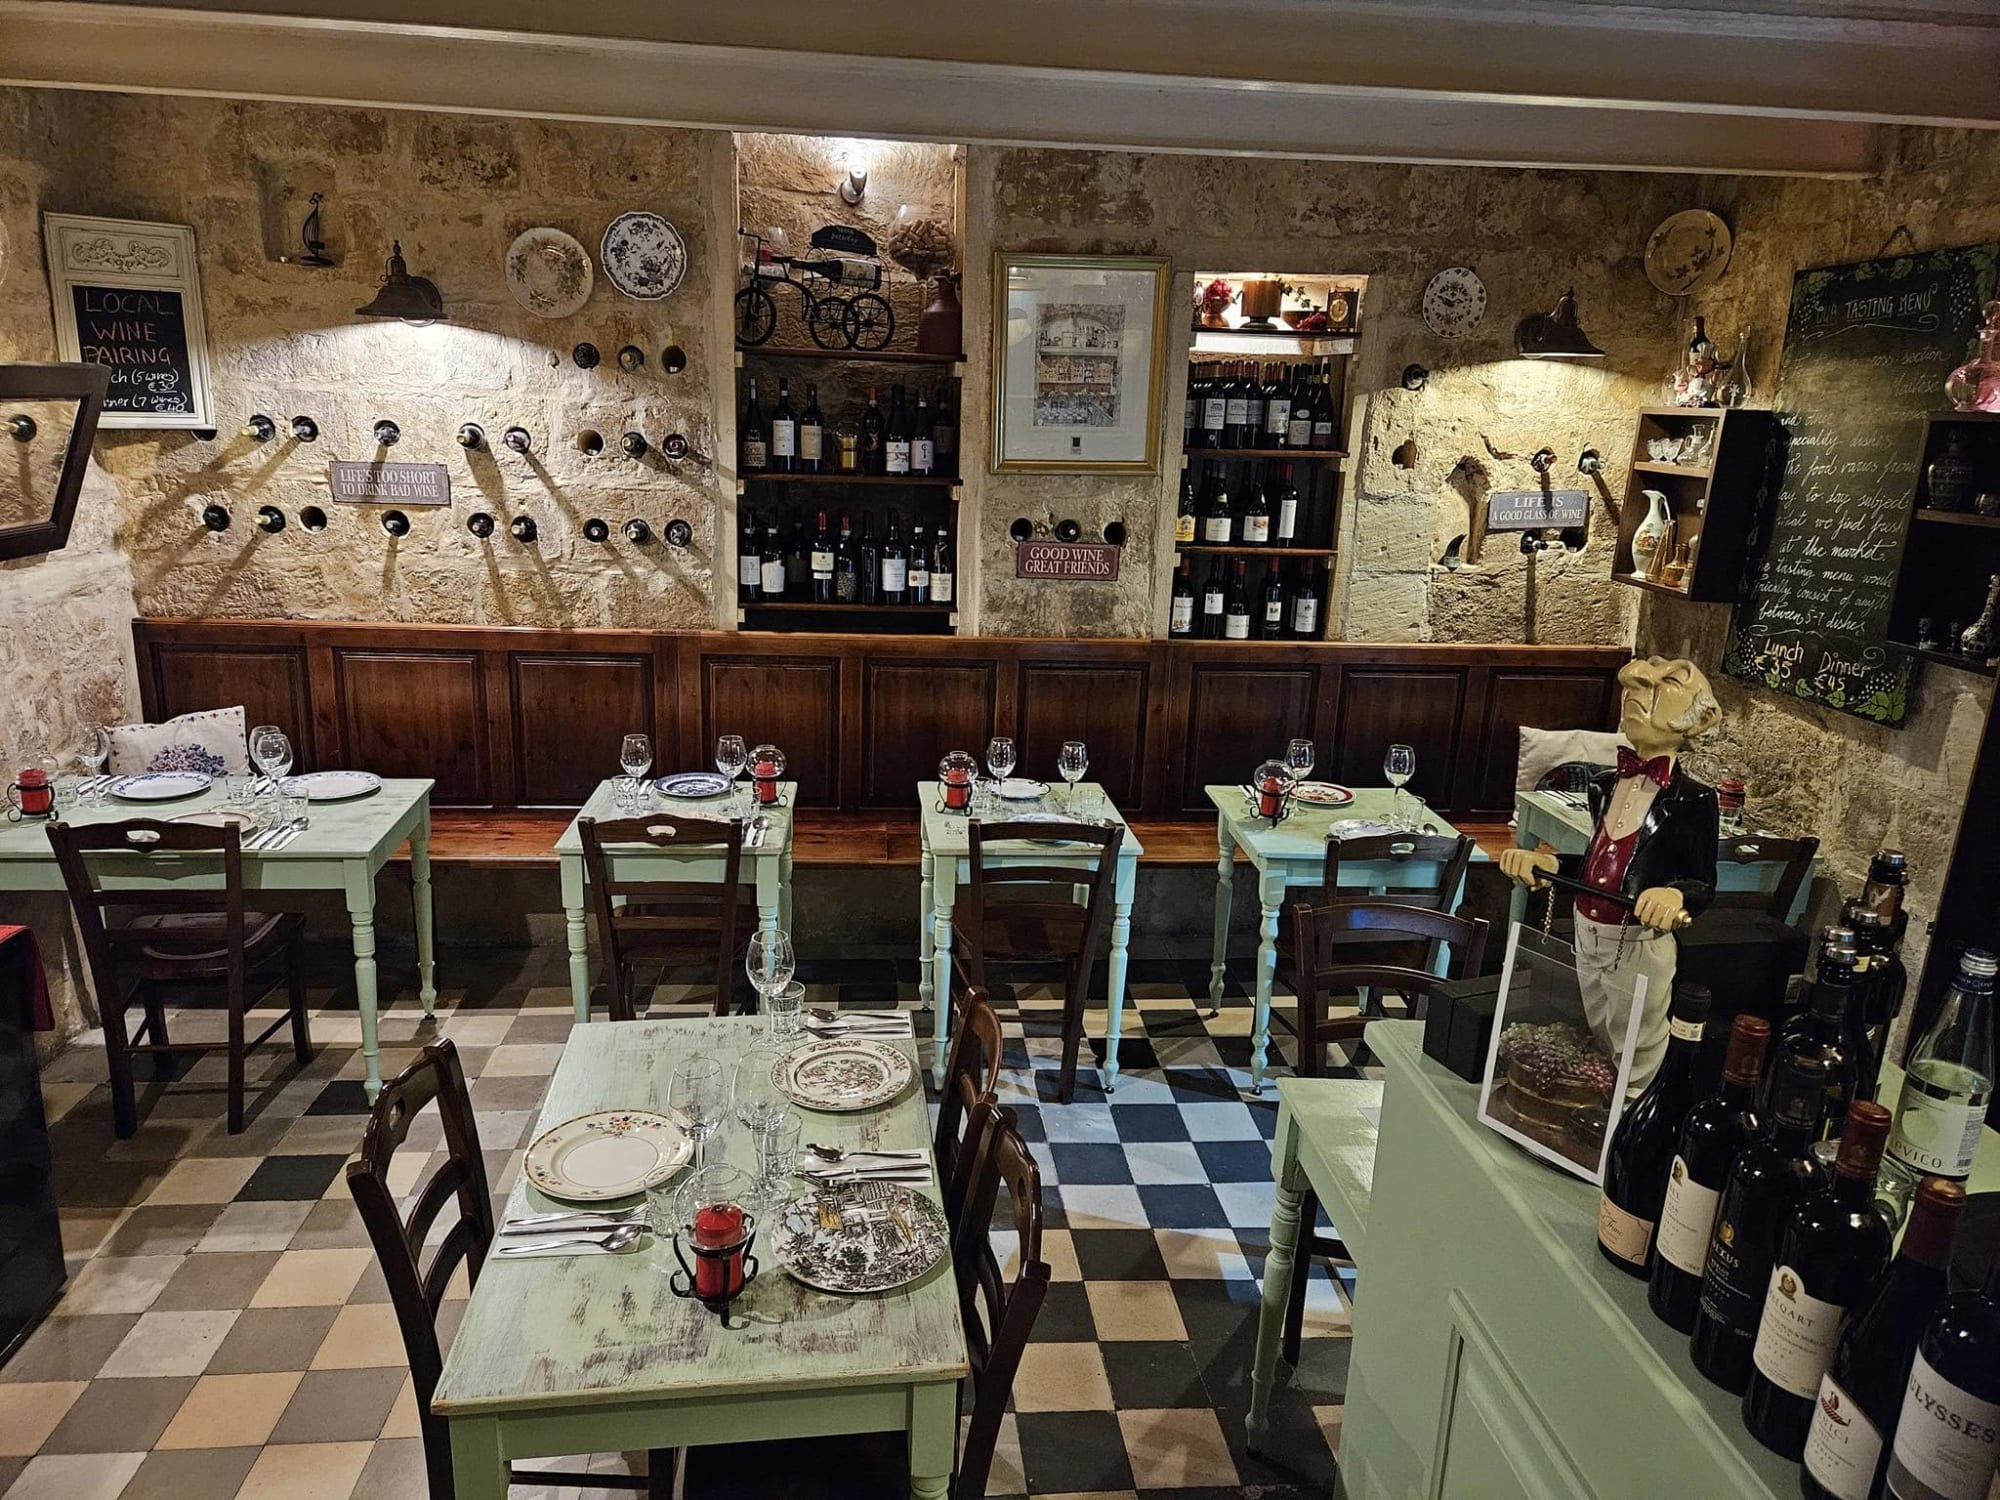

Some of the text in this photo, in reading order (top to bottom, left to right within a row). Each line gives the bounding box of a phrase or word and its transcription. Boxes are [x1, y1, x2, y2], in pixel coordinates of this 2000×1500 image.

[85, 290, 175, 315] LOCAL
[1845, 296, 1894, 320] TASTING
[1898, 282, 1938, 315] MENU
[91, 320, 157, 342] WINE
[83, 346, 171, 365] PAIRING
[148, 381, 176, 393] €30
[155, 403, 185, 412] €40
[1786, 428, 1841, 456] peciality
[340, 469, 437, 484] LIFE'S TOO SHORT
[1784, 453, 1801, 475] The
[1801, 454, 1837, 486] food
[341, 483, 439, 498] TO DRINK BAD WINE
[1514, 496, 1565, 508] LIFE IS
[1857, 488, 1911, 519] subject
[1500, 510, 1522, 521] GOOD
[1523, 510, 1547, 521] GLASS
[1549, 510, 1559, 520] OF
[1562, 508, 1583, 520] WINE
[1030, 546, 1104, 562] GOOD WINE
[1779, 535, 1802, 553] at
[1802, 535, 1827, 557] the
[1025, 559, 1110, 575] GREAT FRIENDS
[1776, 557, 1816, 587] tasting
[1822, 570, 1854, 581] menu
[1796, 586, 1843, 602] consist
[1758, 600, 1804, 625] between
[1826, 612, 1866, 636] dishes
[1764, 638, 1804, 663] Lunch
[1818, 651, 1871, 678] Dinner
[1814, 674, 1846, 691] €45
[1910, 1374, 1996, 1444] ULYSSES
